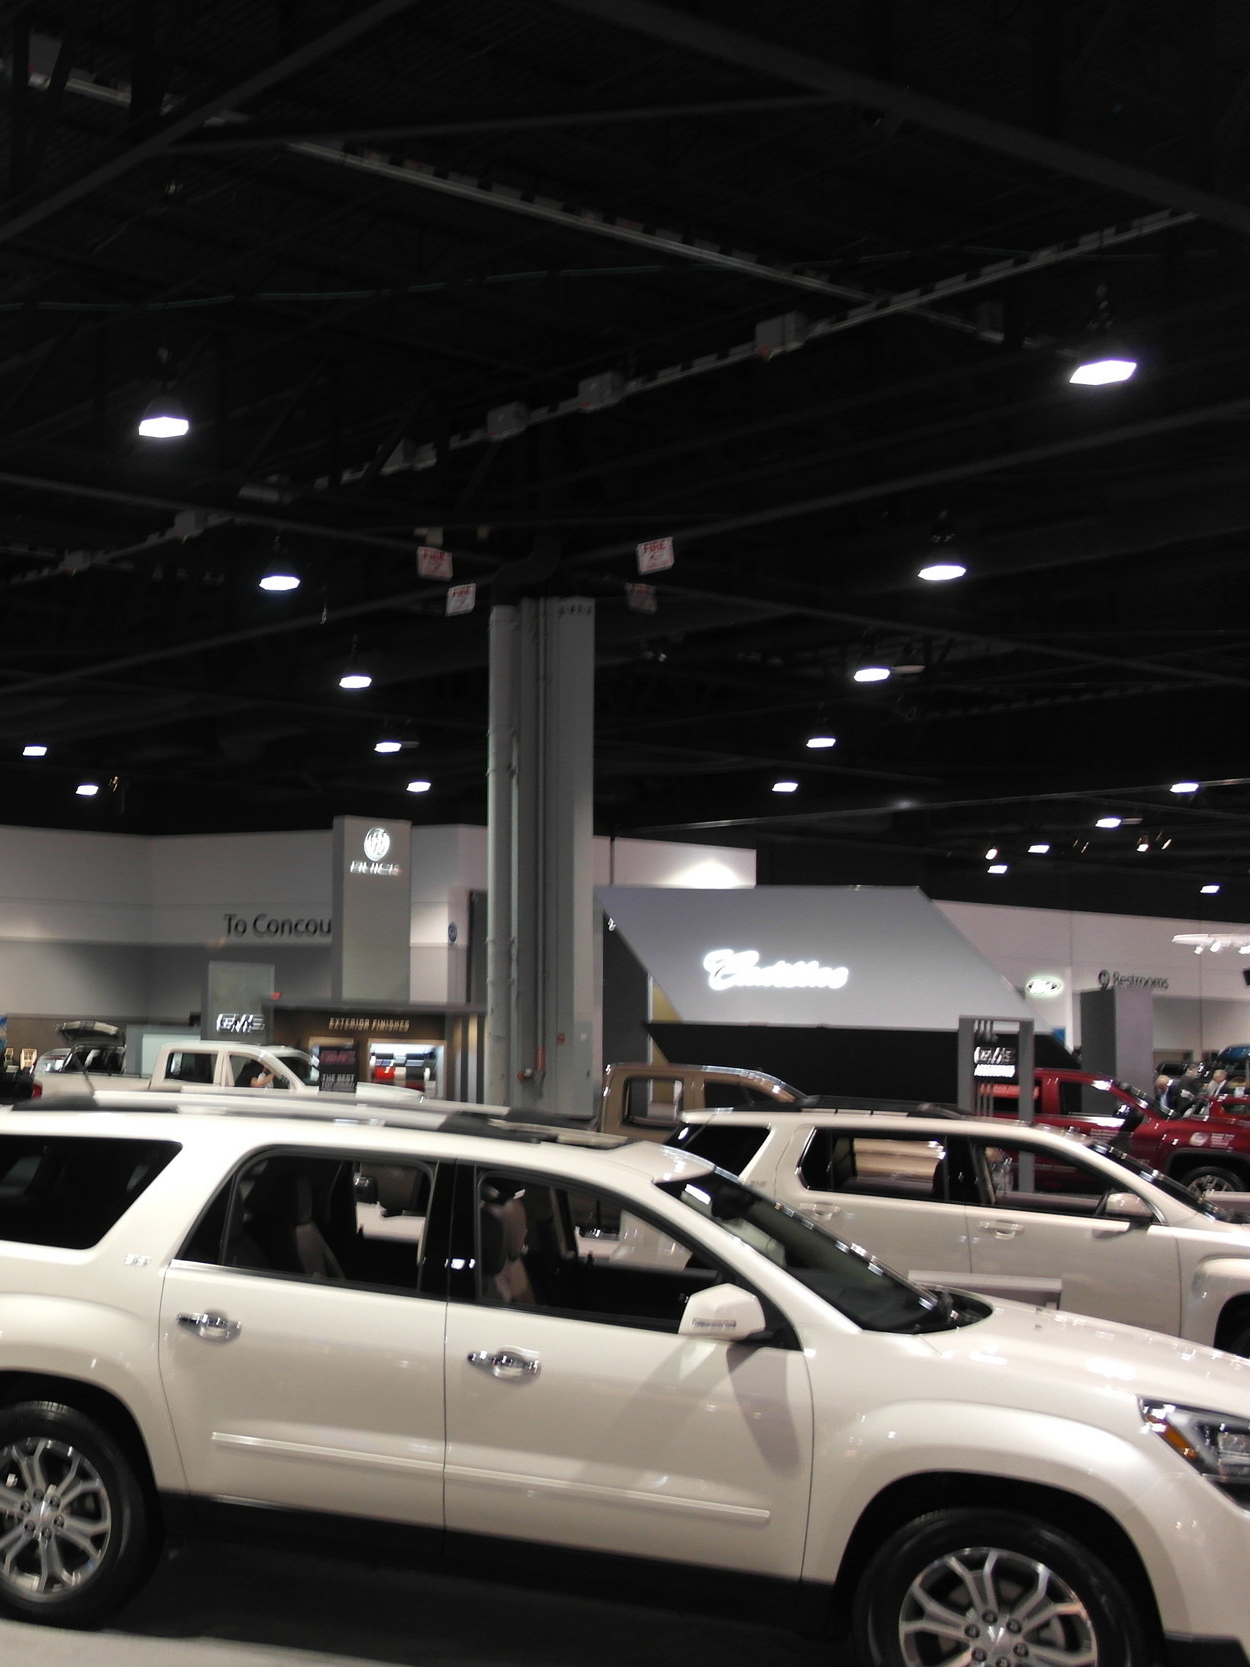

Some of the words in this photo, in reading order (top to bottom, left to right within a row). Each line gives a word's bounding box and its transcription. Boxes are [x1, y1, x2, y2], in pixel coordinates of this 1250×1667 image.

[643, 540, 667, 553] FIRE
[225, 913, 248, 938] To
[1113, 971, 1169, 989] Restrooms
[328, 1017, 370, 1031] EXTERIOR
[371, 1018, 410, 1032] FINISHES
[321, 1073, 336, 1082] THE
